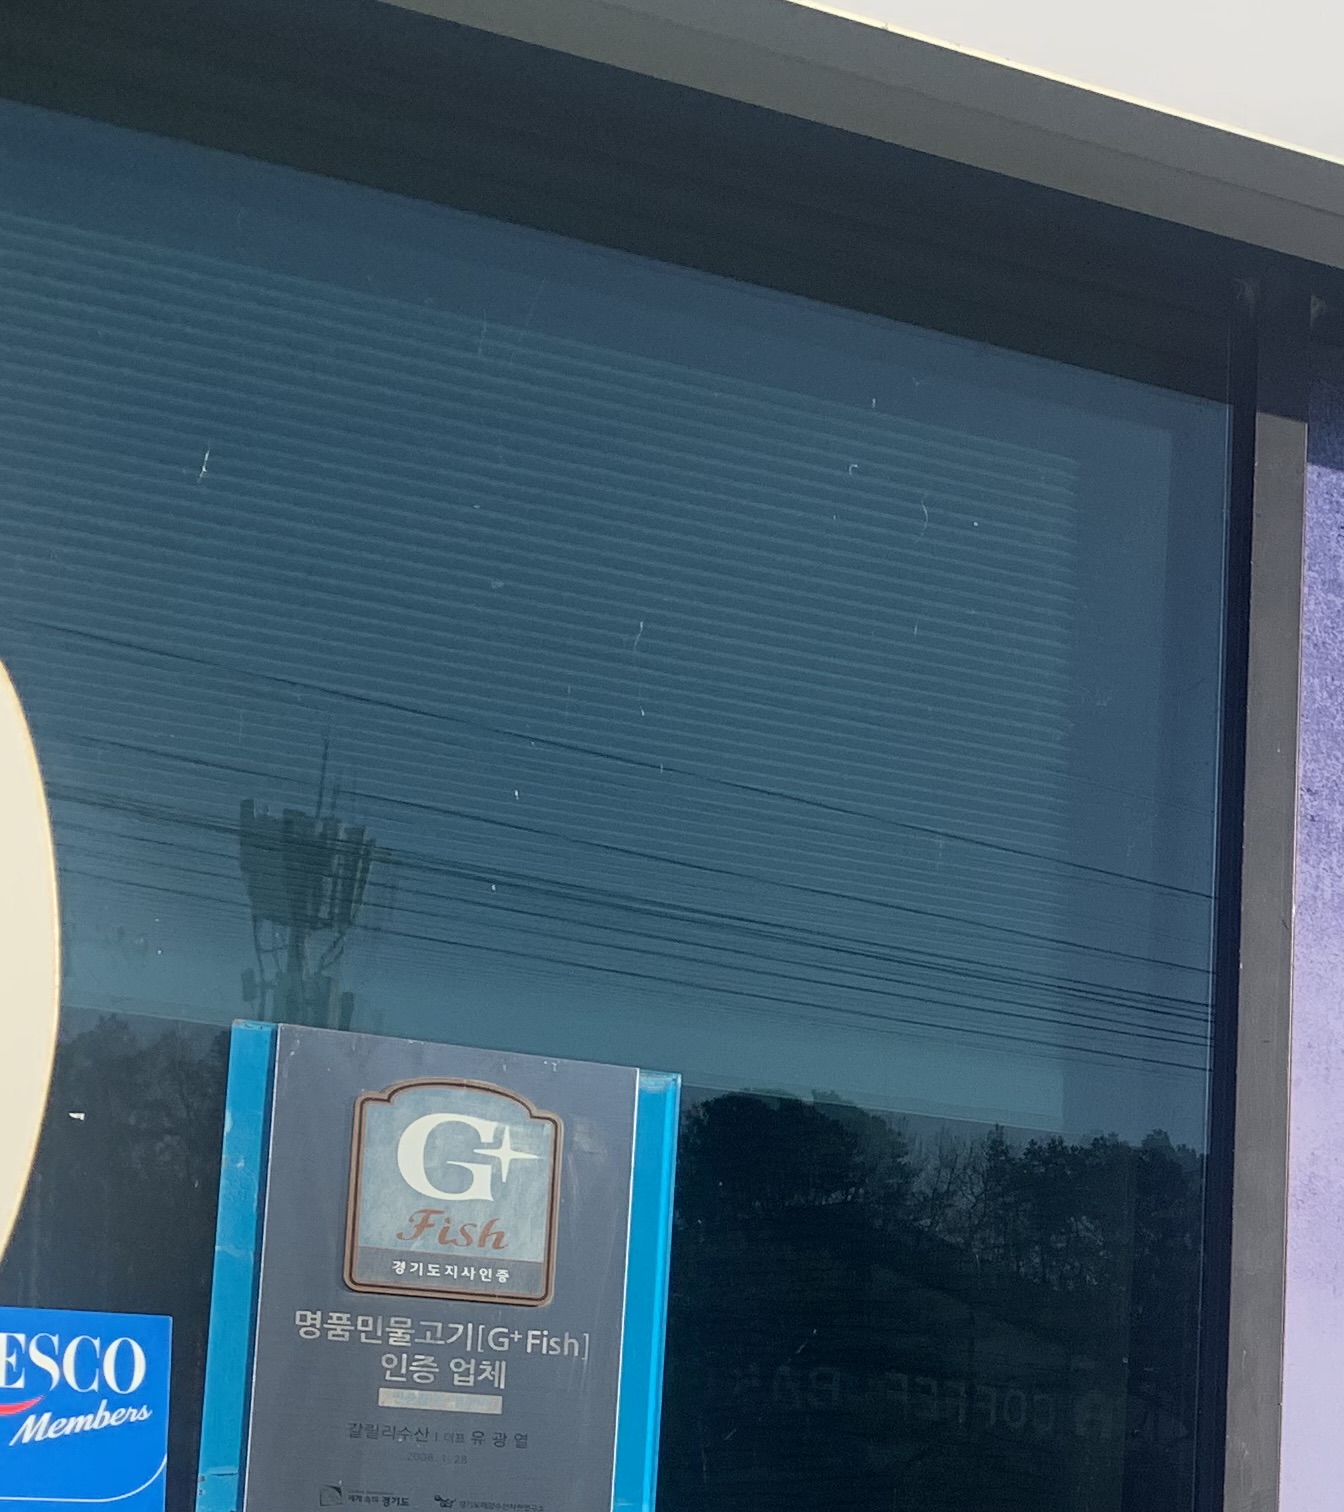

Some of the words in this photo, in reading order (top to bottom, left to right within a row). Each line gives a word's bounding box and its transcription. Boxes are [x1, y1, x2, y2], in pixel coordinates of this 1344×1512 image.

[396, 1208, 511, 1250] Fish
[391, 1259, 511, 1284] 경기도지사인증
[380, 1353, 440, 1385] 인증
[448, 1356, 508, 1391] 업체
[8, 1399, 153, 1446] Members
